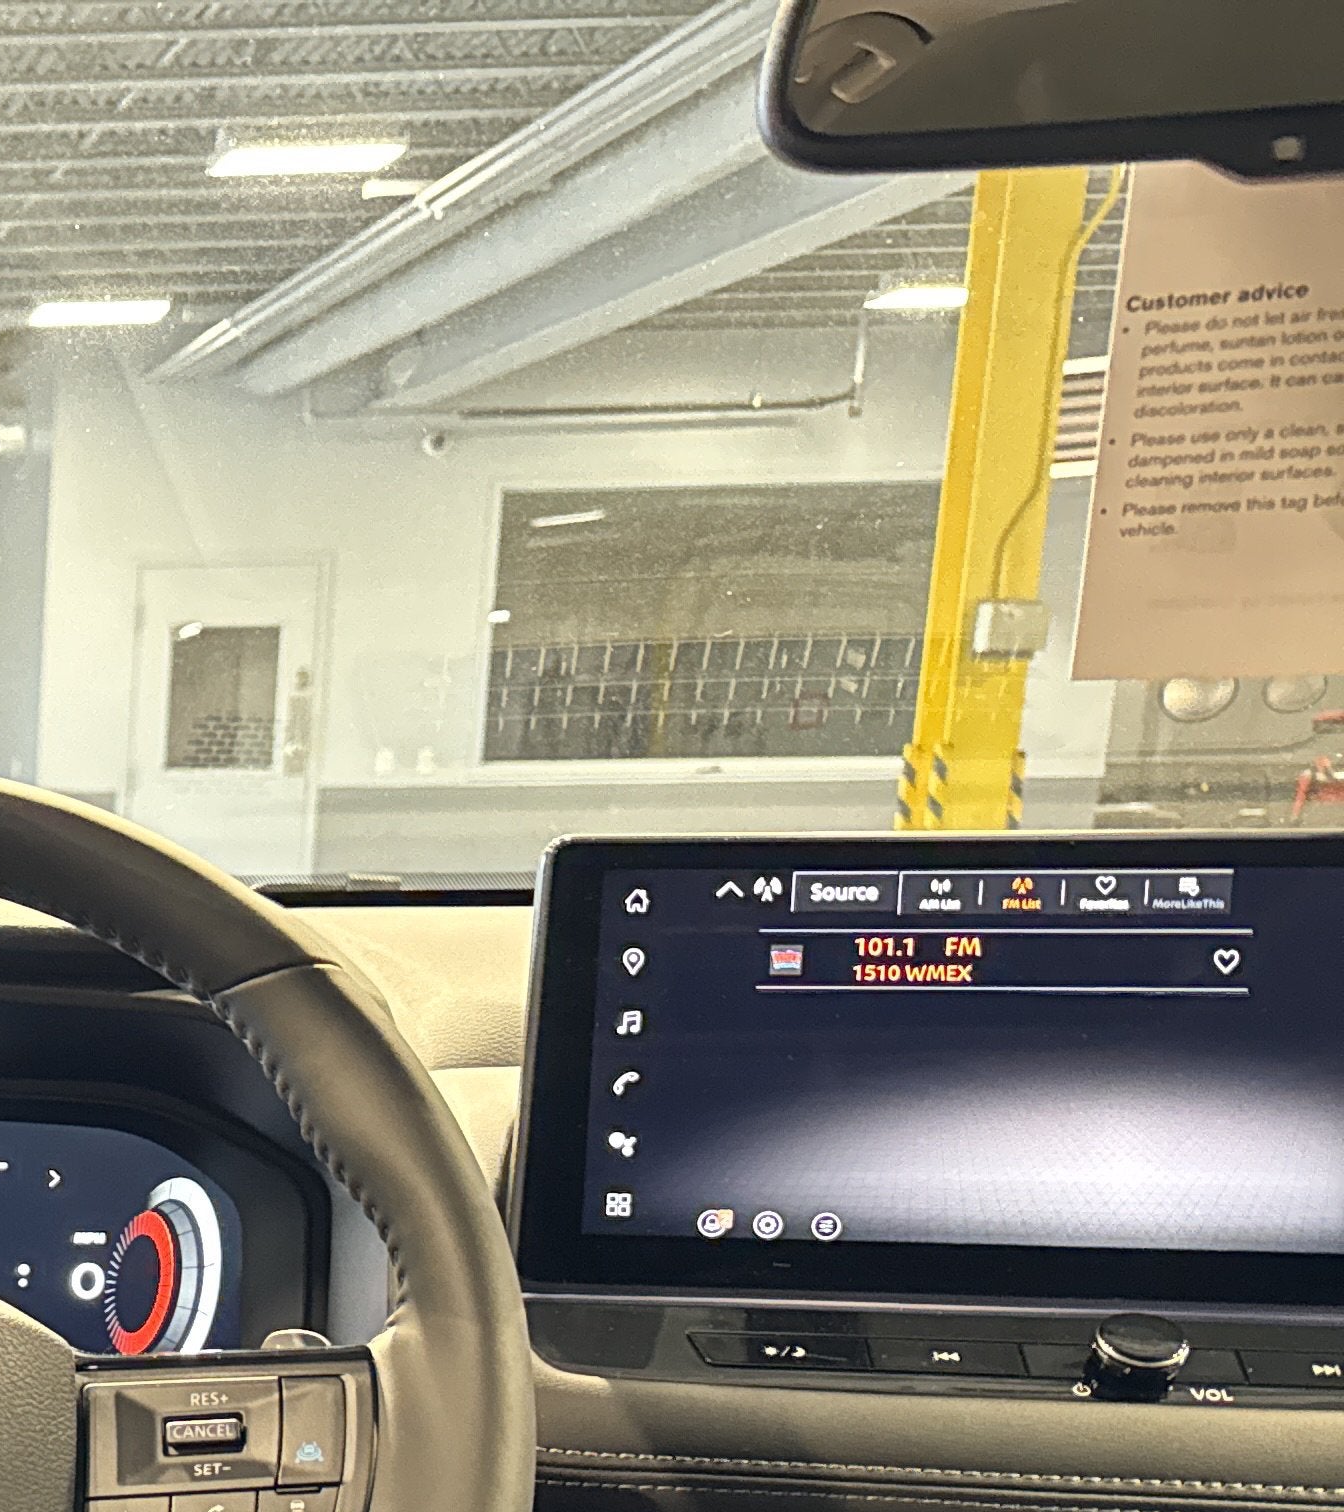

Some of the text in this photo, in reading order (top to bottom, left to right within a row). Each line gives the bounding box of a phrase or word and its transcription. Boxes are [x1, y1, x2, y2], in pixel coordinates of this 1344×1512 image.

[1126, 283, 1310, 313] Customer advice
[1144, 319, 1201, 336] Please
[1205, 316, 1228, 331] do
[1232, 313, 1260, 329] not
[1264, 311, 1285, 326] let
[1290, 310, 1312, 324] air
[1141, 339, 1214, 359] perfume,
[1219, 334, 1277, 350] suntan
[1281, 329, 1328, 346] lotion
[1139, 360, 1213, 380] products
[1217, 357, 1265, 372] come
[1269, 354, 1285, 367] in
[1136, 381, 1193, 398] interior
[1269, 374, 1281, 388] It
[1285, 373, 1317, 388] can
[1133, 399, 1244, 420] discoloration.
[1130, 432, 1186, 448] Please
[1190, 430, 1221, 446] use
[1225, 426, 1259, 444] only
[1263, 427, 1275, 440] a
[1127, 449, 1216, 469] dampened
[1219, 450, 1235, 463] in
[1239, 445, 1275, 461] mild
[1278, 445, 1321, 460] soap
[1124, 474, 1194, 490] cleaning
[1198, 469, 1256, 485] interior
[1122, 502, 1177, 517] Please
[1180, 499, 1241, 514] remove
[1246, 497, 1276, 511] this
[1280, 495, 1308, 513] tag
[1119, 521, 1178, 538] vehicle.
[810, 882, 879, 902] Source
[1002, 898, 1042, 910] FM List
[1152, 898, 1225, 910] MoreLikeThis
[854, 937, 983, 957] 101.1 FM
[852, 964, 974, 983] 1510 WMEX
[71, 1262, 106, 1301] 0
[190, 1391, 229, 1406] RES+
[1189, 1387, 1234, 1402] VOL
[172, 1424, 235, 1440] CANCEL
